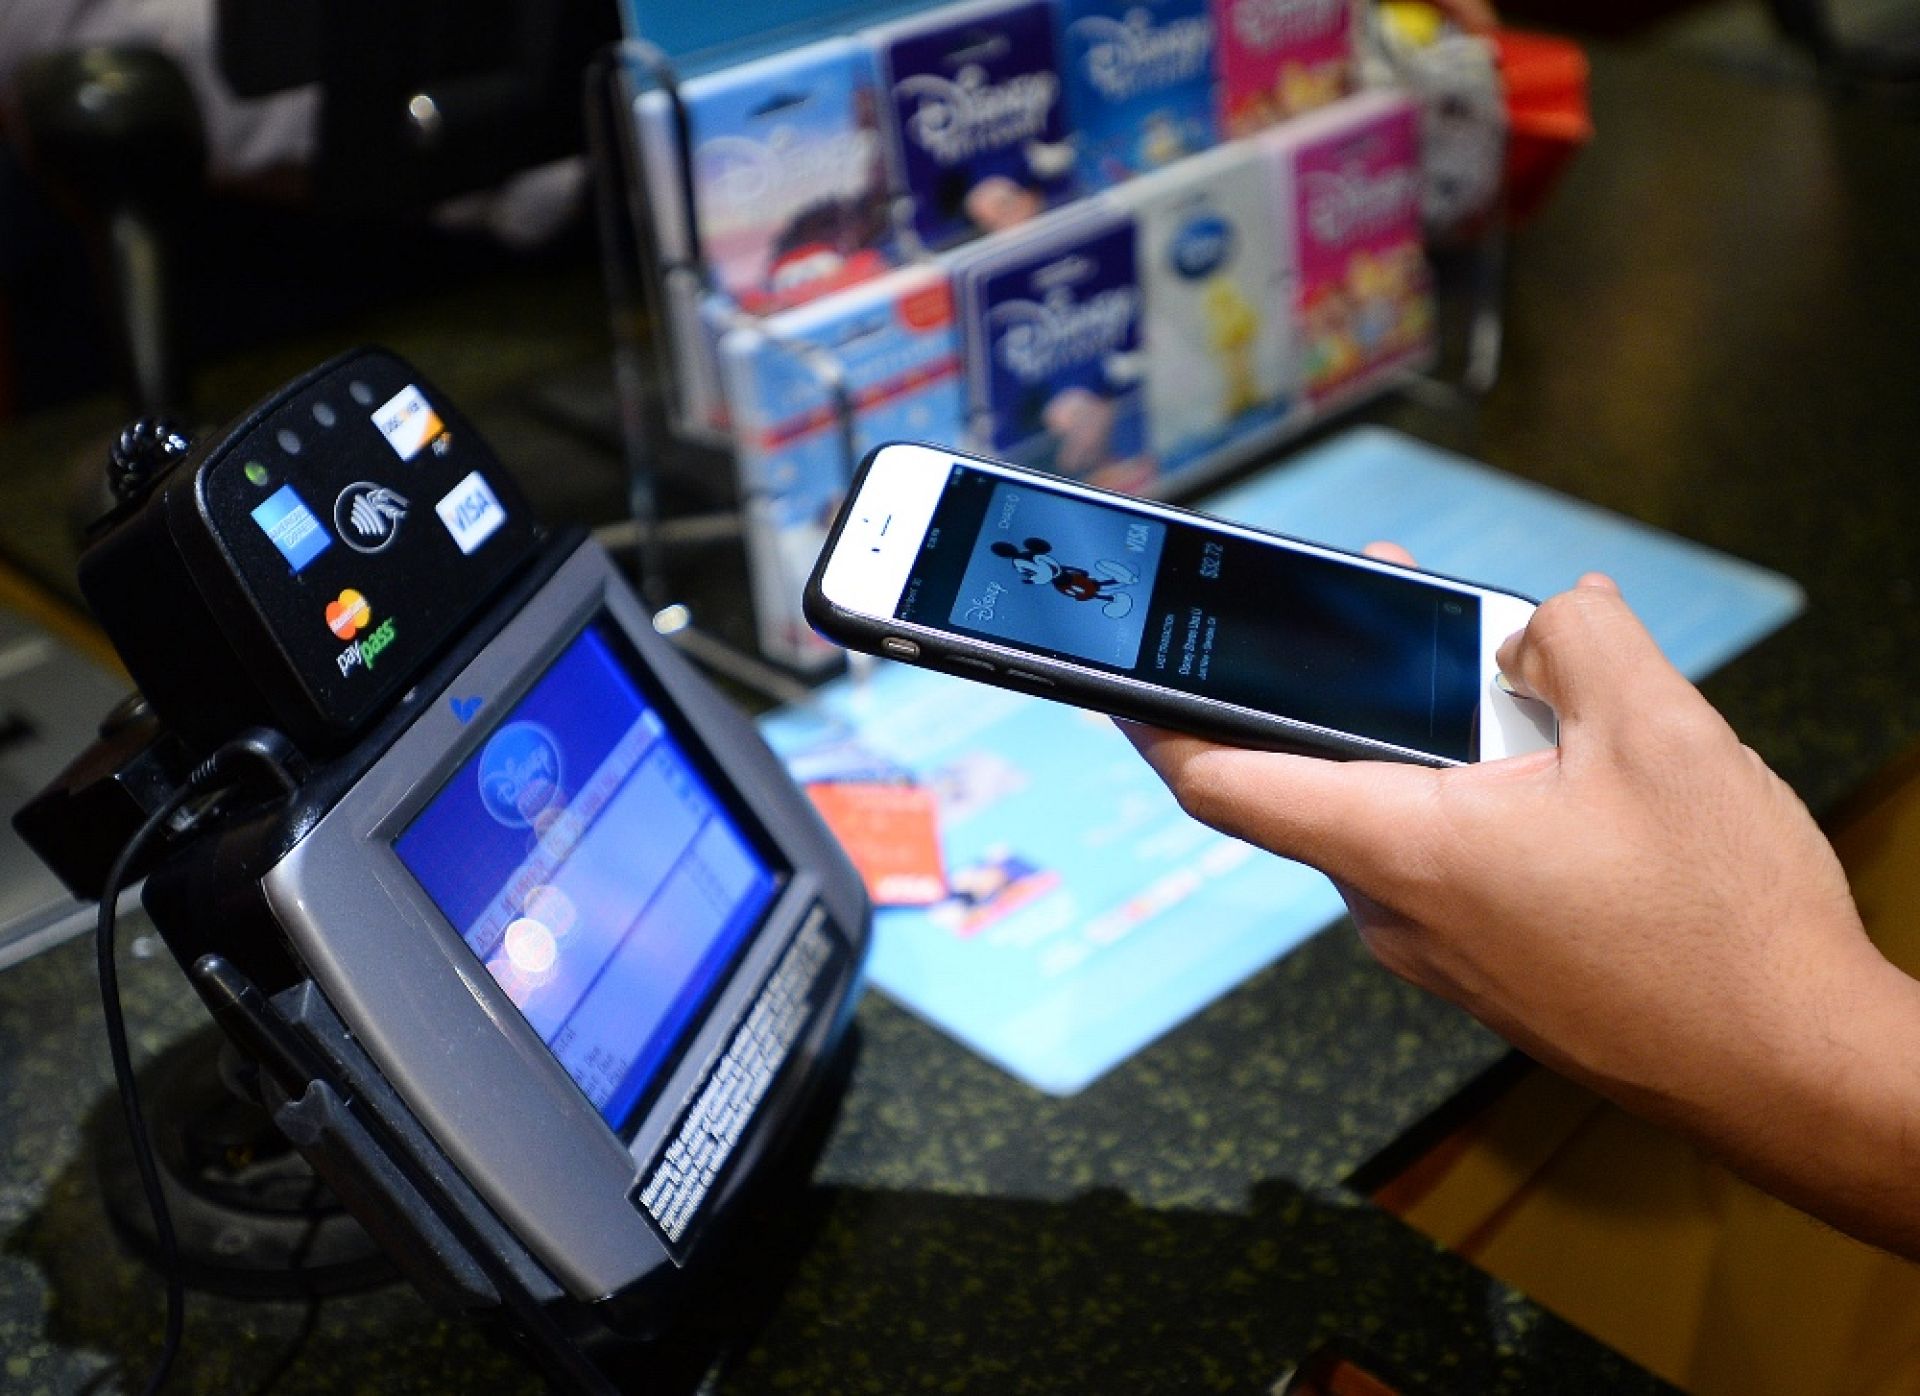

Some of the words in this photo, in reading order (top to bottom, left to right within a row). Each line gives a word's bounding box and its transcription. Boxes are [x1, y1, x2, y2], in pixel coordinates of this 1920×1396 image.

[892, 64, 1060, 163] Disney
[985, 287, 1138, 376] Disney
[453, 489, 491, 532] VISA
[1126, 523, 1150, 552] VISA
[965, 581, 1008, 621] Disney
[484, 748, 553, 805] Disney
